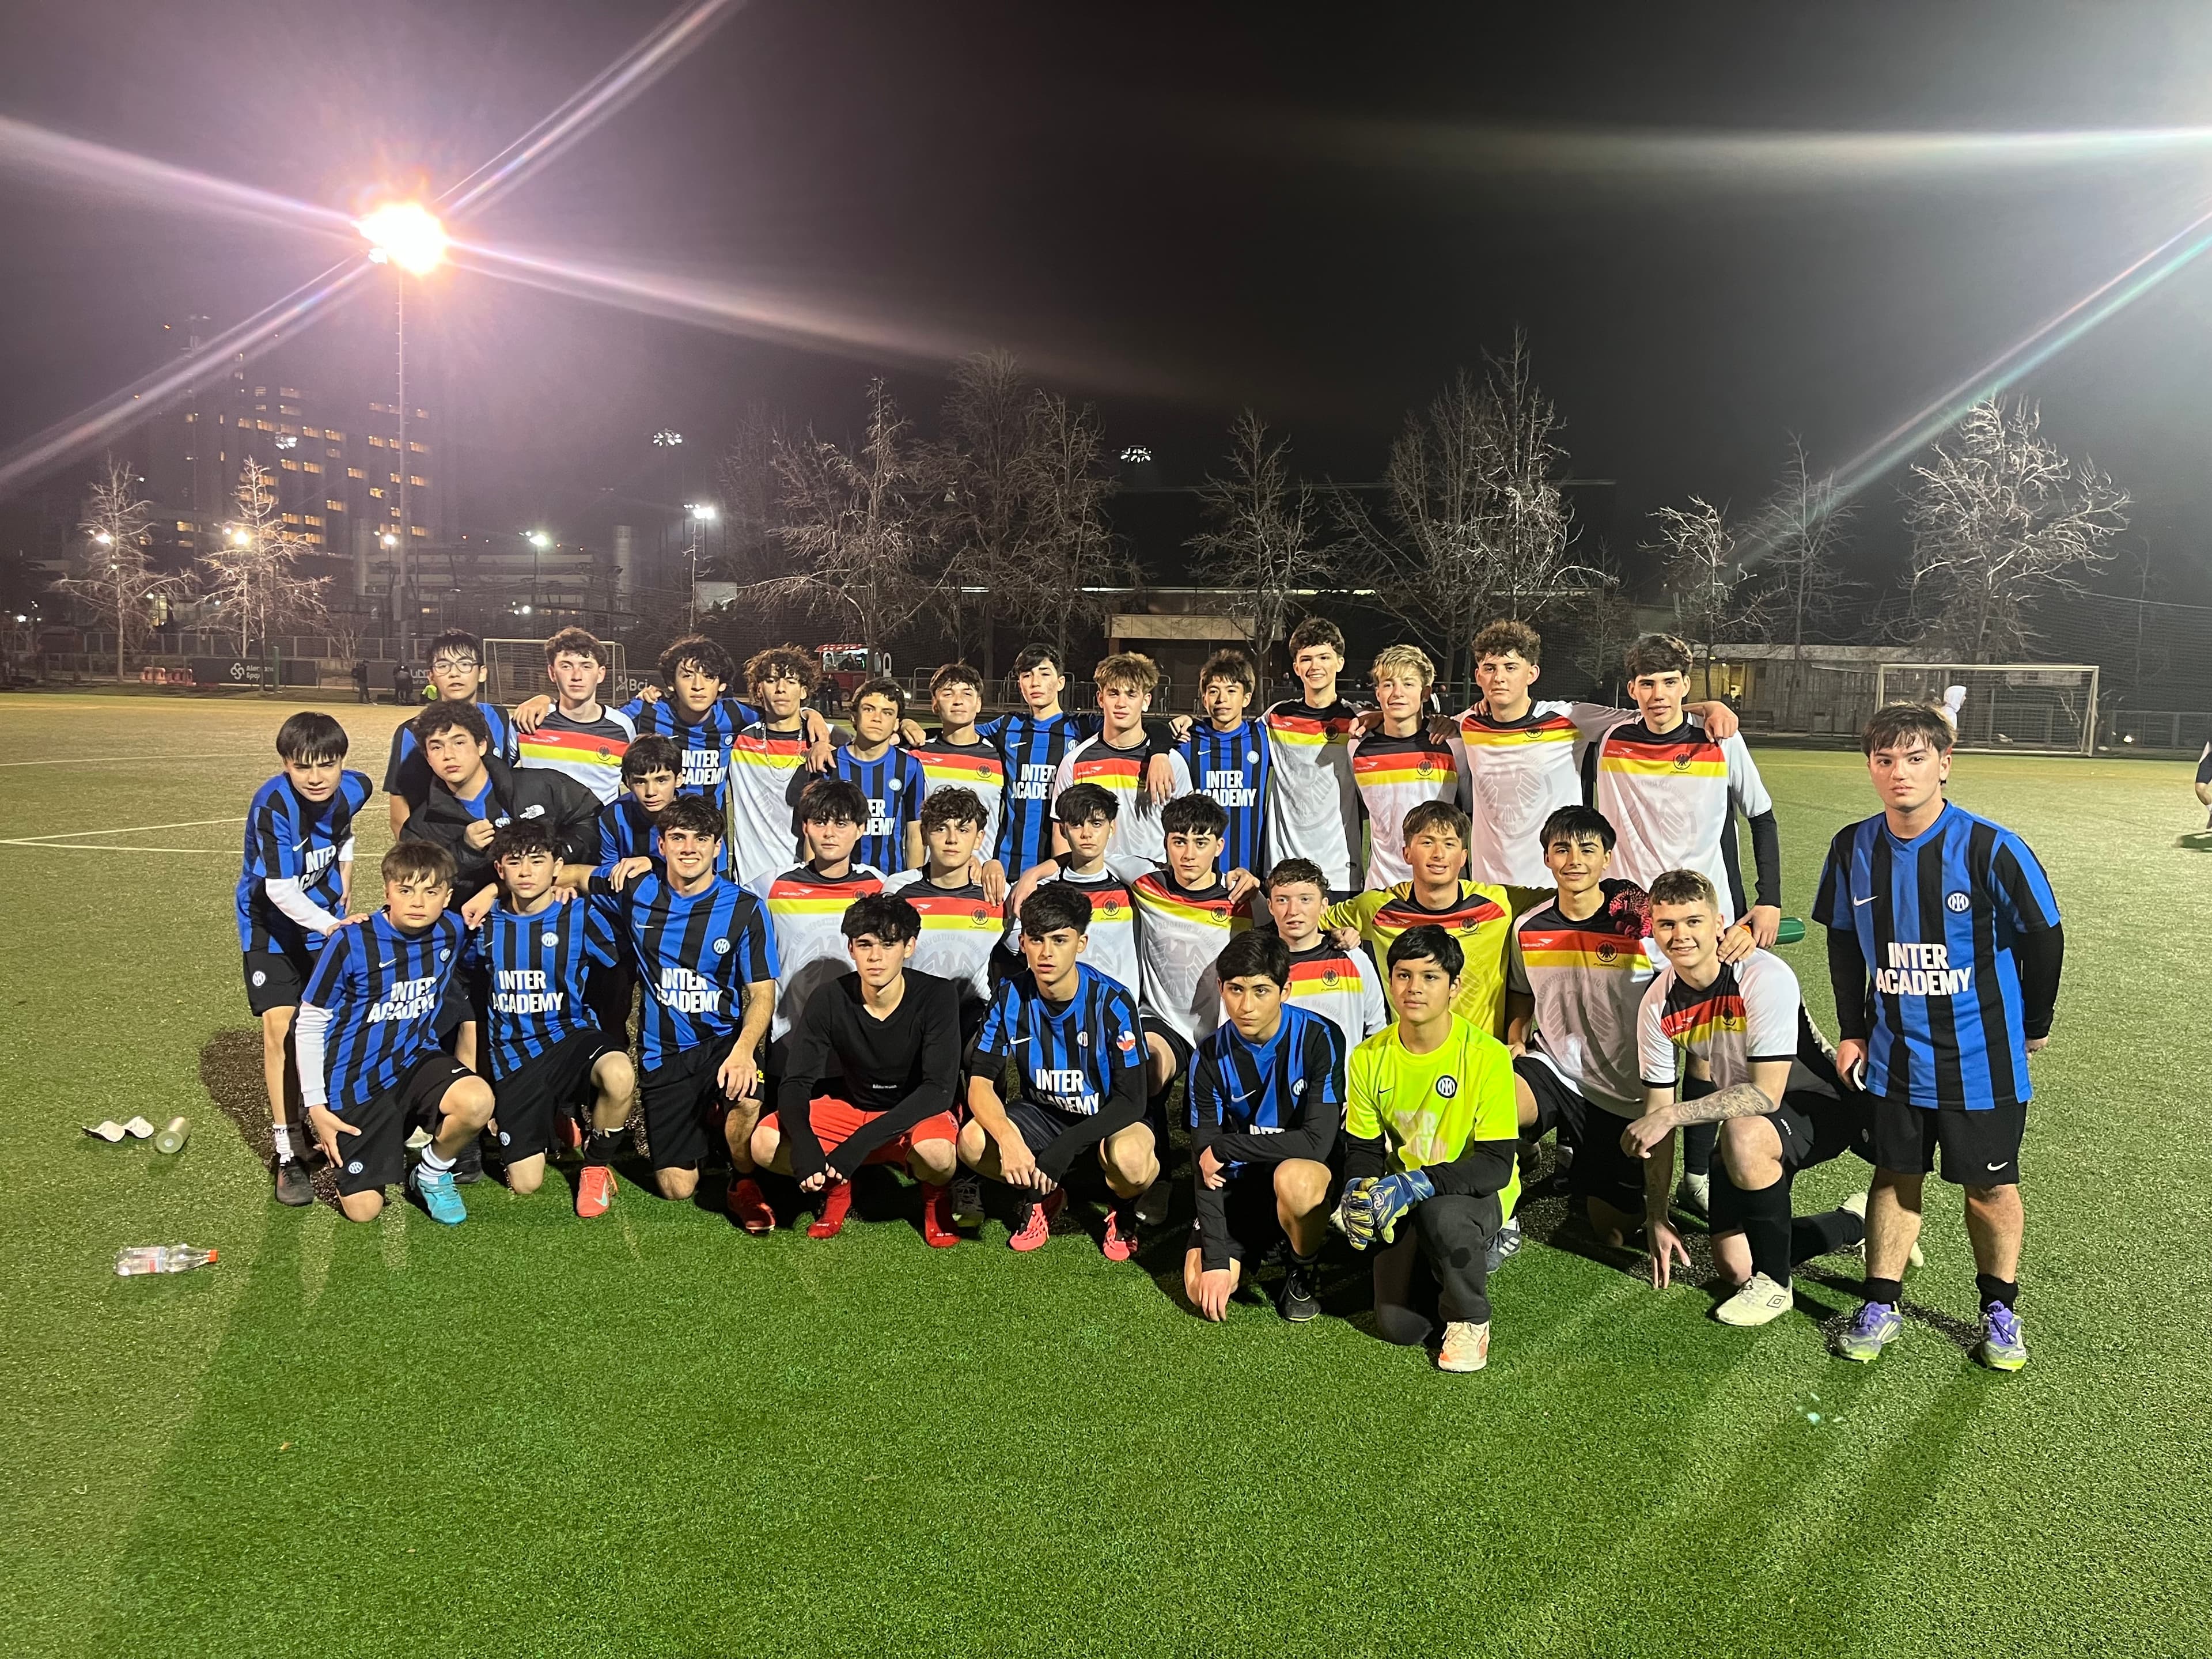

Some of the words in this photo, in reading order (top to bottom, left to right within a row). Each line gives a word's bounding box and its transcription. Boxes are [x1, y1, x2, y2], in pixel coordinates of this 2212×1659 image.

[629, 679, 648, 691] Bci
[681, 749, 719, 767] INTER
[681, 767, 728, 785] CADEMY
[1206, 770, 1244, 788] INTER
[1011, 782, 1054, 800] ACADE
[1195, 789, 1257, 807] ADEMY
[863, 818, 896, 835] DEMY
[1888, 942, 1949, 969] INTER
[498, 970, 547, 990] INTER
[1876, 967, 1971, 995] ACADEMY
[366, 993, 435, 1022] ACADEM
[493, 993, 563, 1014] ACADEMY
[1036, 1069, 1084, 1092] INTER
